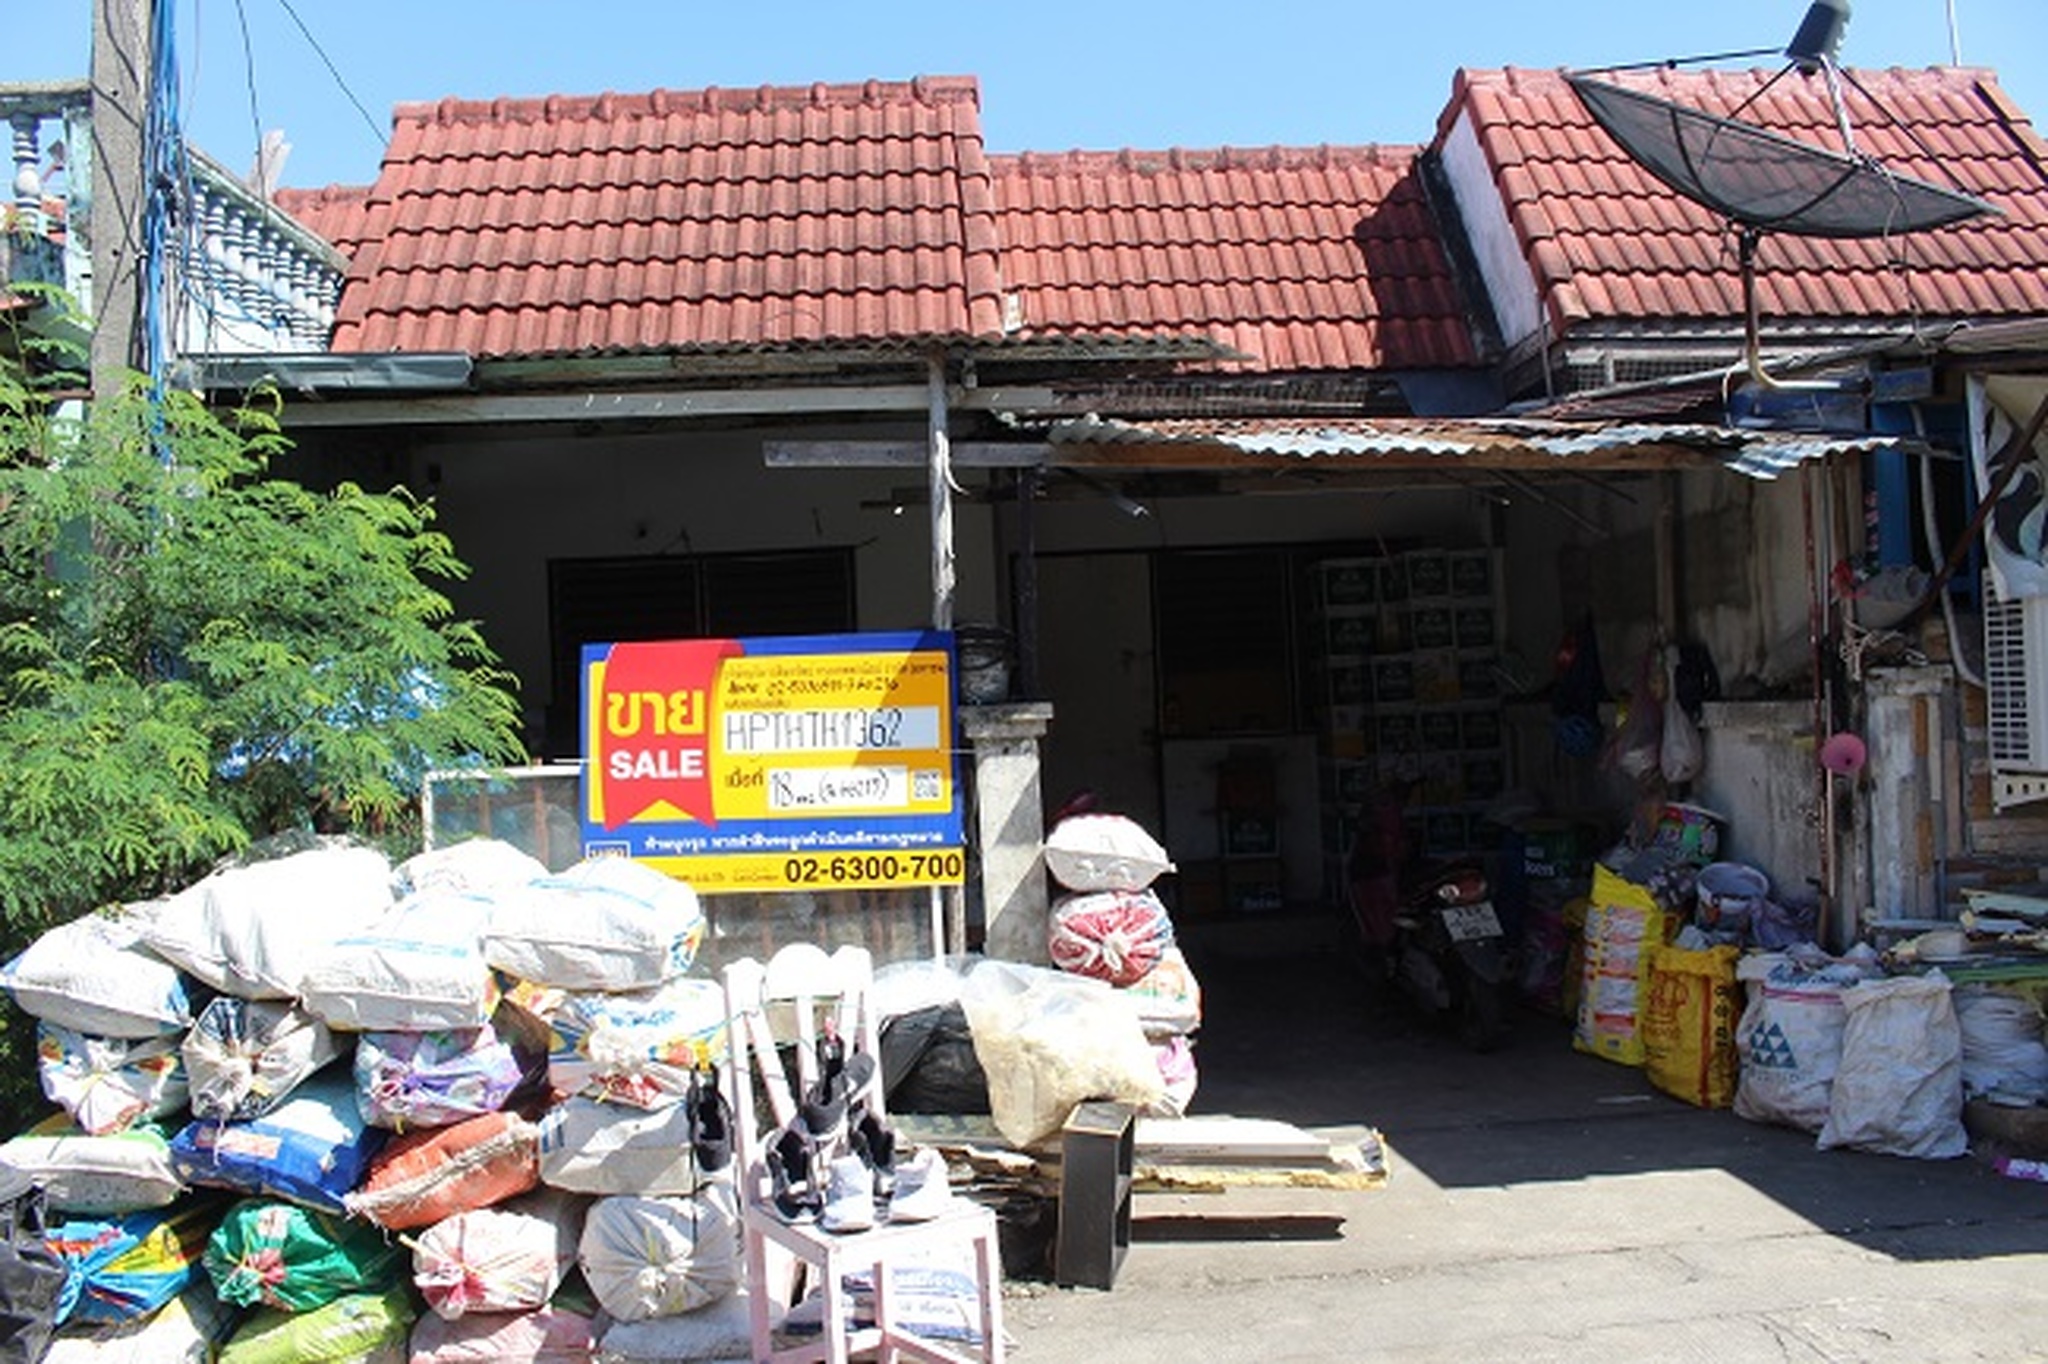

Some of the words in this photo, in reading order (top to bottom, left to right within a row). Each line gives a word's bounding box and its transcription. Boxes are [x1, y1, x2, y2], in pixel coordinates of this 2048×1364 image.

[608, 690, 705, 737] ขาย
[610, 749, 704, 780] SALE
[785, 853, 962, 884] 02-6300-700
